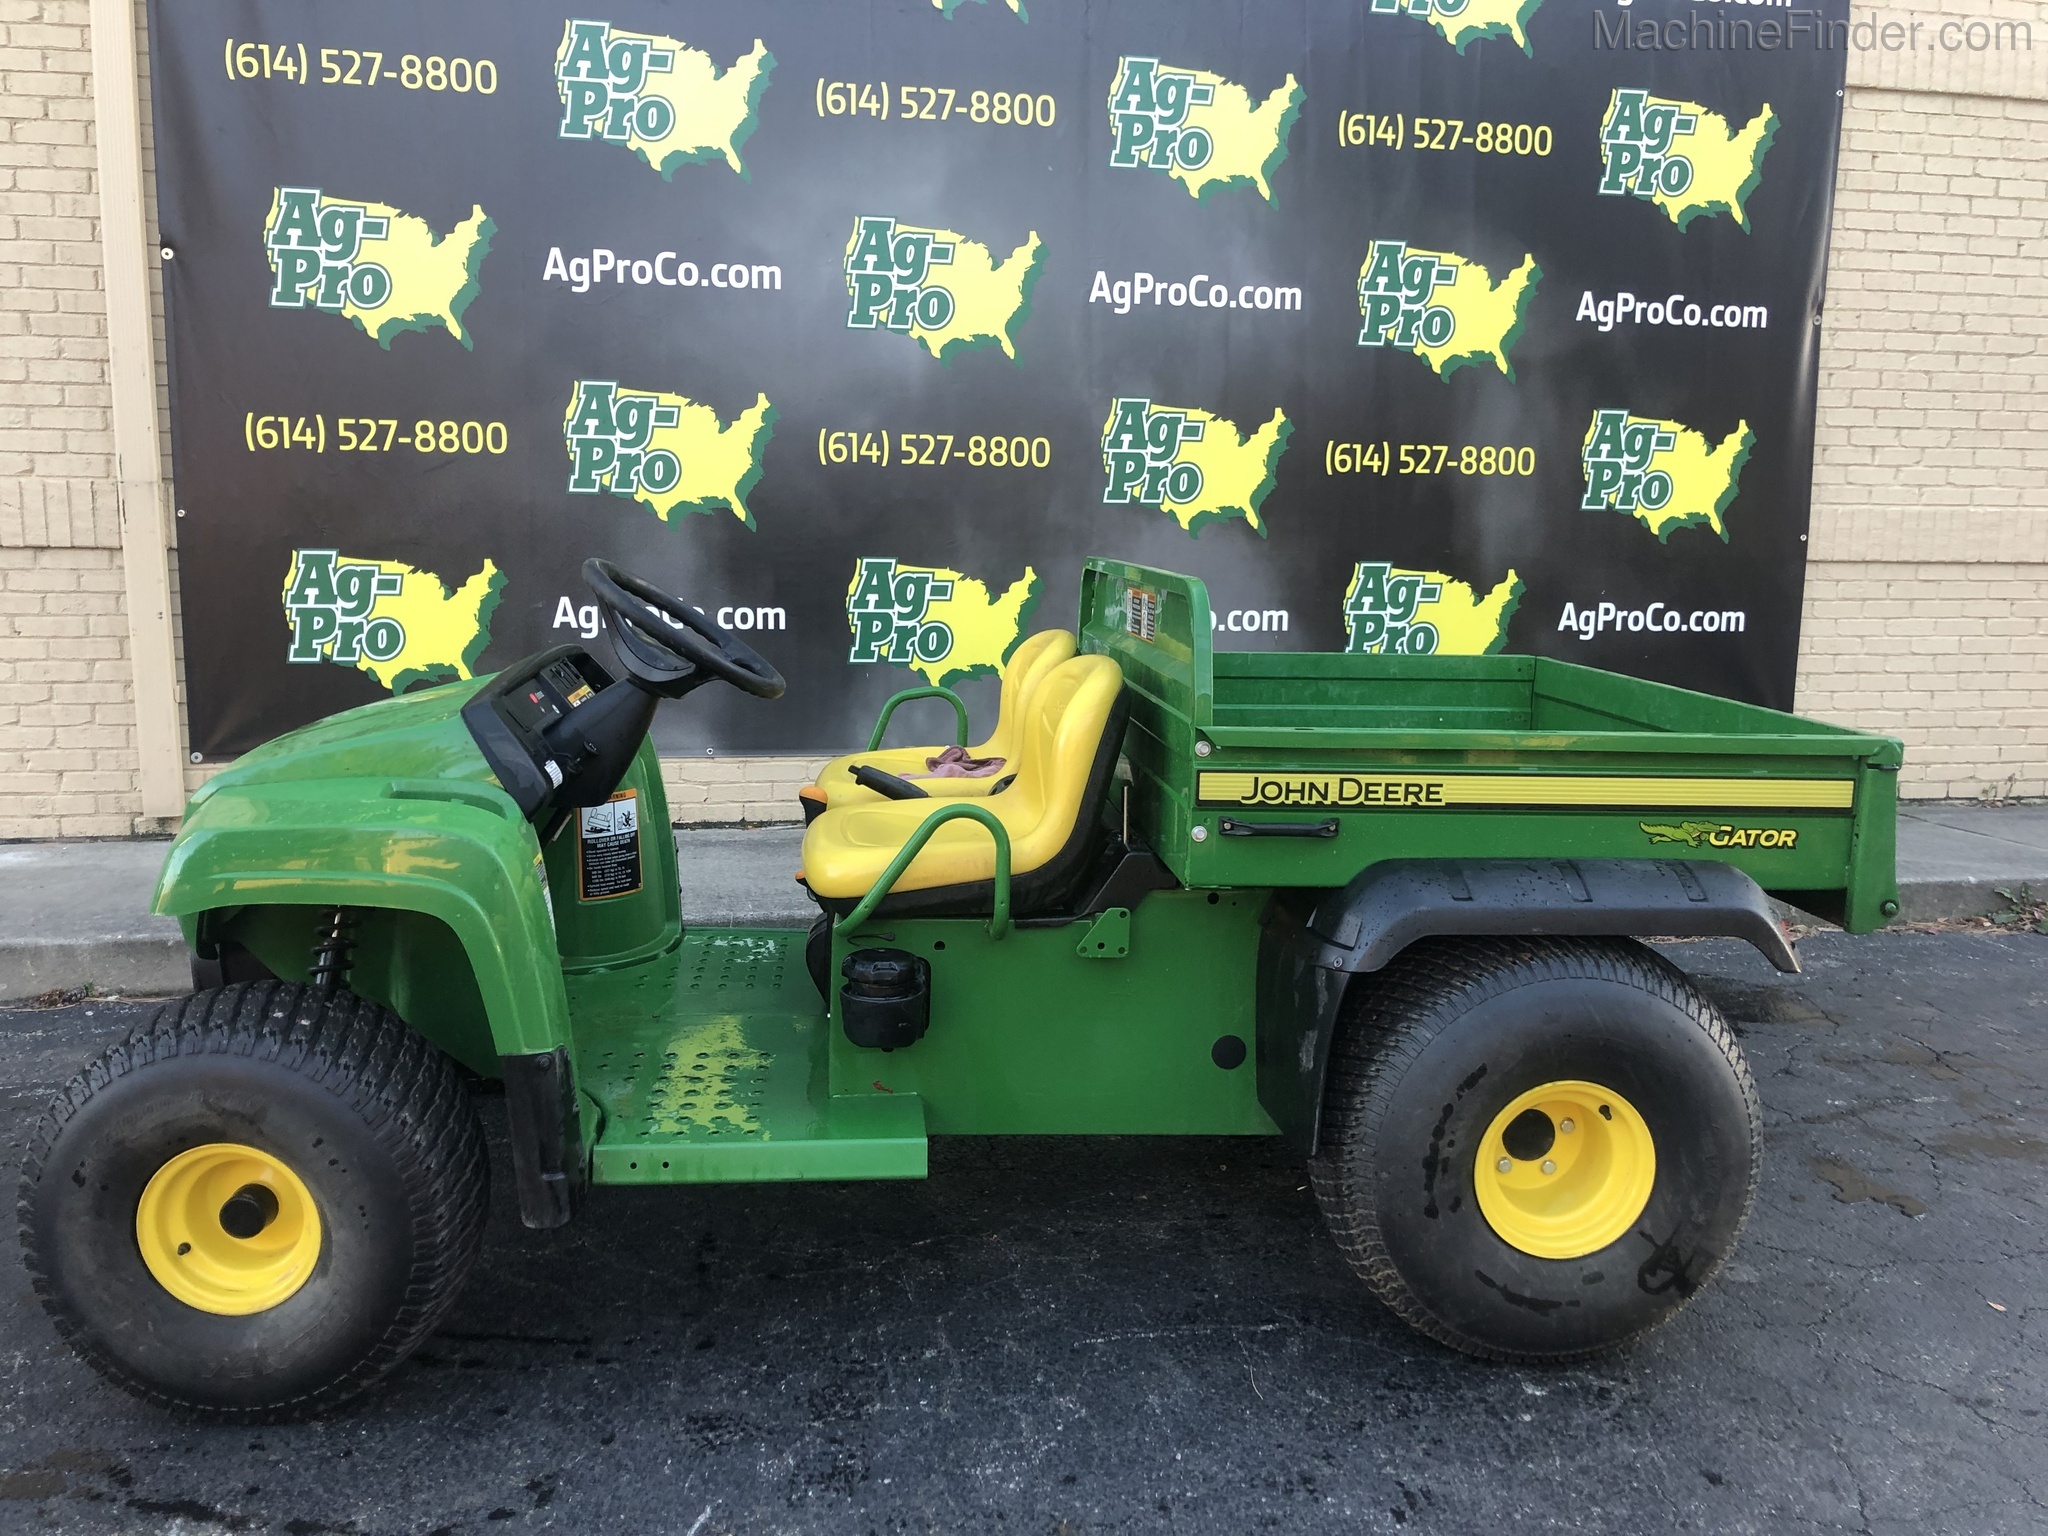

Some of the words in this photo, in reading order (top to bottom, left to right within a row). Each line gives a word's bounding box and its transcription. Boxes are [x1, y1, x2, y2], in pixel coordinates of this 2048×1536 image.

[226, 39, 307, 85] (614)
[321, 49, 497, 95] 527-8800
[559, 20, 674, 94] Ag-
[560, 79, 675, 141] Pro
[817, 78, 888, 121] (614)
[901, 87, 1055, 127] 527-8800
[1113, 57, 1214, 126] Ag-
[1111, 112, 1213, 170] Pro
[1339, 110, 1403, 151] (614)
[1414, 118, 1553, 156] 527-8800
[1601, 89, 1697, 155] Ag-
[1599, 141, 1693, 196] Pro
[268, 188, 389, 261] Ag-
[849, 217, 954, 286] Ag-
[271, 247, 391, 309] Pro
[543, 246, 782, 293] AgProCo.com
[1089, 271, 1302, 315] AgProCo.com
[1361, 240, 1458, 306] Ag-
[847, 272, 954, 329] Pro
[1358, 291, 1454, 347] Pro
[1576, 291, 1768, 332] AgProCo.com
[246, 413, 325, 453] (614)
[339, 419, 508, 454] 527-8800
[567, 381, 680, 450] Ag-
[1105, 398, 1205, 462] Ag-
[1584, 410, 1676, 471] Ag-
[570, 436, 680, 493] Pro
[819, 429, 889, 467] (614)
[902, 434, 1050, 468] 527-8800
[1103, 449, 1203, 504] Pro
[1326, 441, 1390, 476] (614)
[1400, 445, 1535, 476] 527-8800
[1582, 458, 1672, 510] Pro
[286, 550, 404, 619] Ag-
[851, 558, 955, 622] Ag-
[1349, 563, 1442, 624] Ag-
[288, 604, 405, 662] Pro
[849, 609, 953, 662] Pro
[1345, 611, 1439, 654] Pro
[1557, 602, 1745, 641] AgProCo.com
[1240, 776, 1329, 802] JOHN
[1338, 777, 1444, 803] DEERE
[1708, 825, 1798, 848] GATOR
